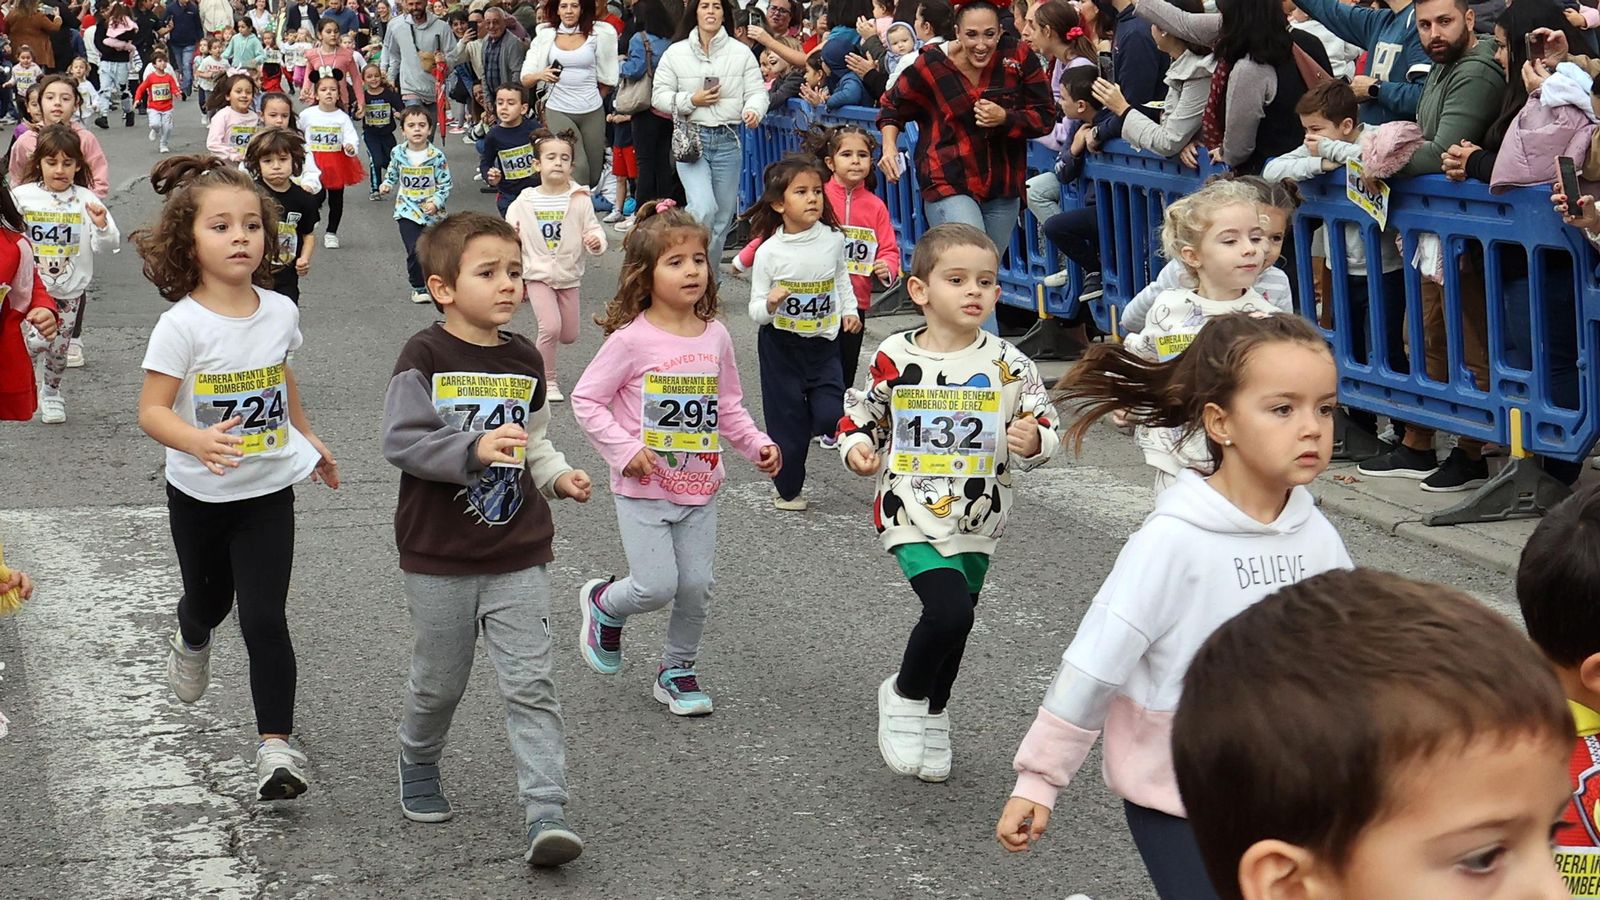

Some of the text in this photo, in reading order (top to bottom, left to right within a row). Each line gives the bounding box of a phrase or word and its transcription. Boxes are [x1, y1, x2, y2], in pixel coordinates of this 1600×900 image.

[235, 134, 251, 146] 64
[314, 133, 338, 144] 414
[403, 176, 430, 188] 022
[31, 225, 72, 243] 641
[785, 294, 831, 317] 844
[663, 353, 696, 370] SAVED
[198, 373, 233, 384] CARRERA
[234, 368, 266, 382] INFANTIL
[441, 375, 476, 387] CARRERA
[477, 376, 509, 388] INFANTIL
[649, 374, 680, 385] CARRERA
[680, 376, 706, 385] INFANTIL
[213, 381, 255, 394] BOMBEROS
[256, 378, 265, 388] DE
[457, 386, 525, 399] BOMBEROS DE JEREZ
[662, 385, 695, 395] BOMBEROS
[696, 386, 705, 394] DE
[896, 388, 925, 399] CARRERA
[926, 389, 960, 400] INFANTIL
[212, 390, 284, 429] 724
[907, 399, 983, 411] BOMBEROS DE JEREZ
[658, 399, 718, 428] 295
[907, 415, 983, 449] 132
[673, 471, 713, 481] SHOUT
[1233, 554, 1306, 590] BELIEVE
